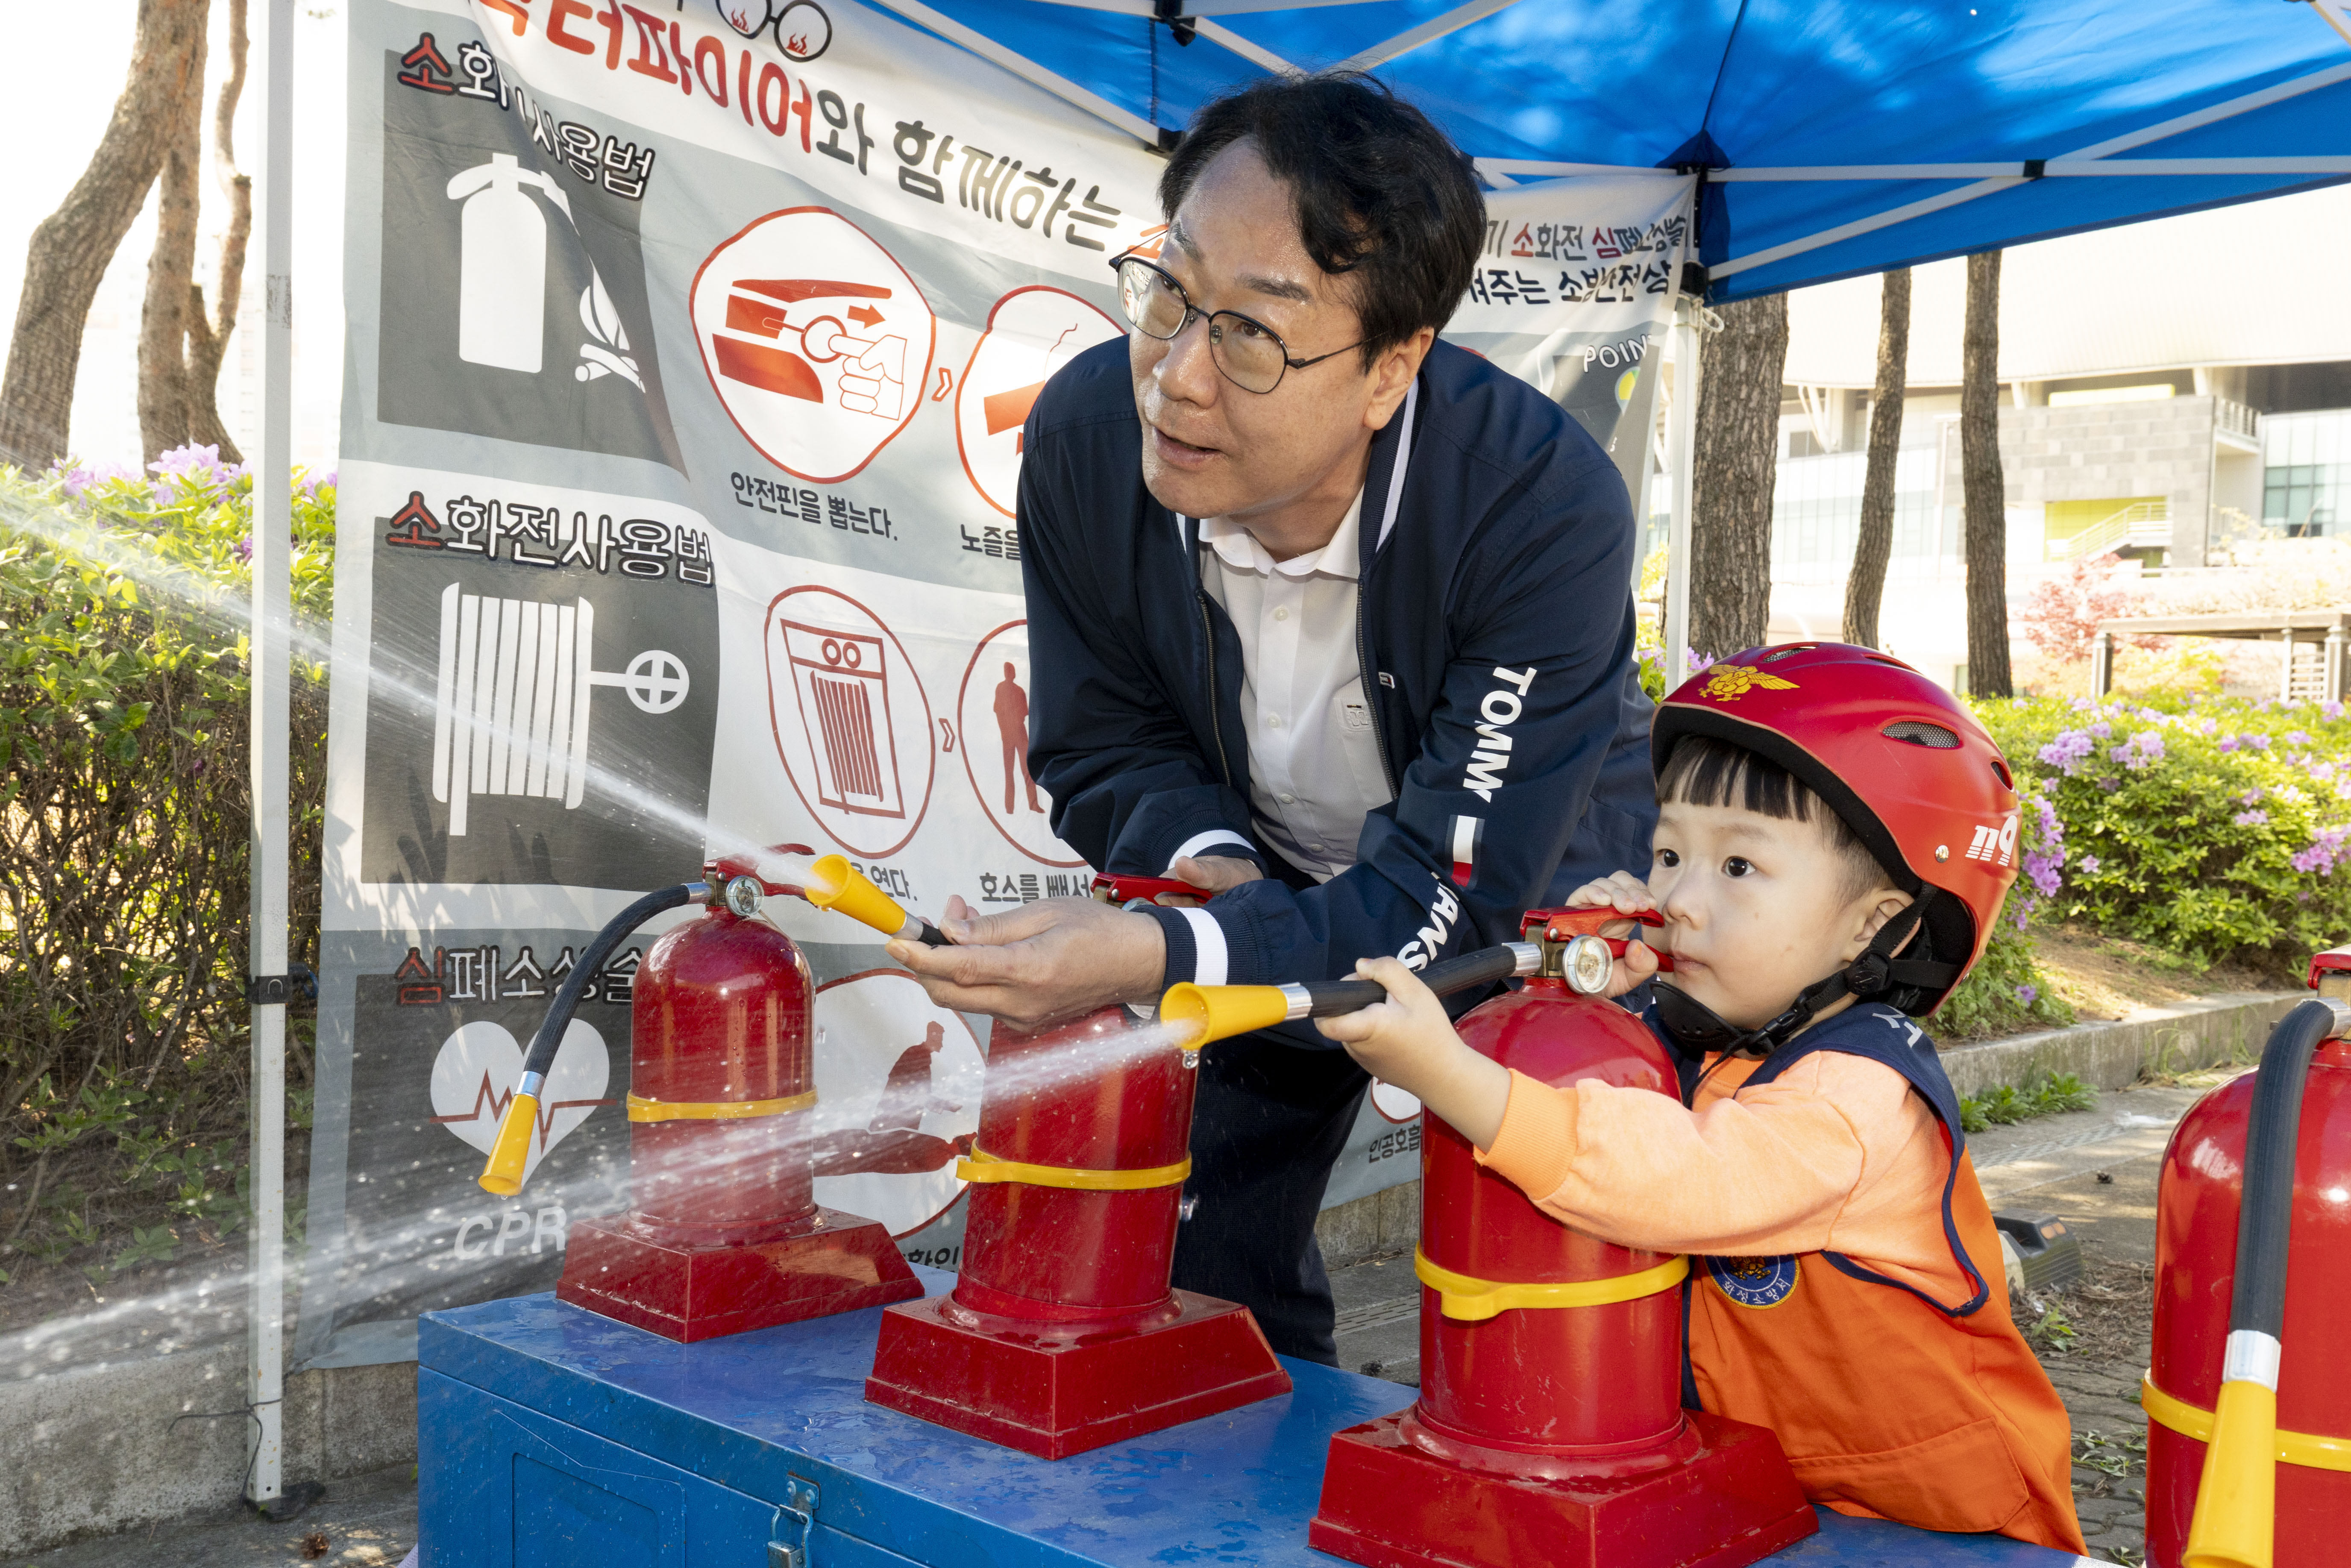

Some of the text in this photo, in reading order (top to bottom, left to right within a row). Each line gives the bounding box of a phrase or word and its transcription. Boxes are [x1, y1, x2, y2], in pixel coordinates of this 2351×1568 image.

[478, 0, 874, 176] 터파이어와
[893, 120, 1121, 252] 함께하는
[1511, 222, 1587, 261] 소화전
[1583, 333, 1652, 373] POIN
[731, 471, 898, 541] 안전핀을 뽑는다.
[385, 490, 715, 587] 소화전사용법
[1462, 666, 1538, 803] TOMM
[1965, 815, 2018, 867] 119
[979, 872, 1040, 904] 호스를
[453, 1206, 567, 1260] CPR
